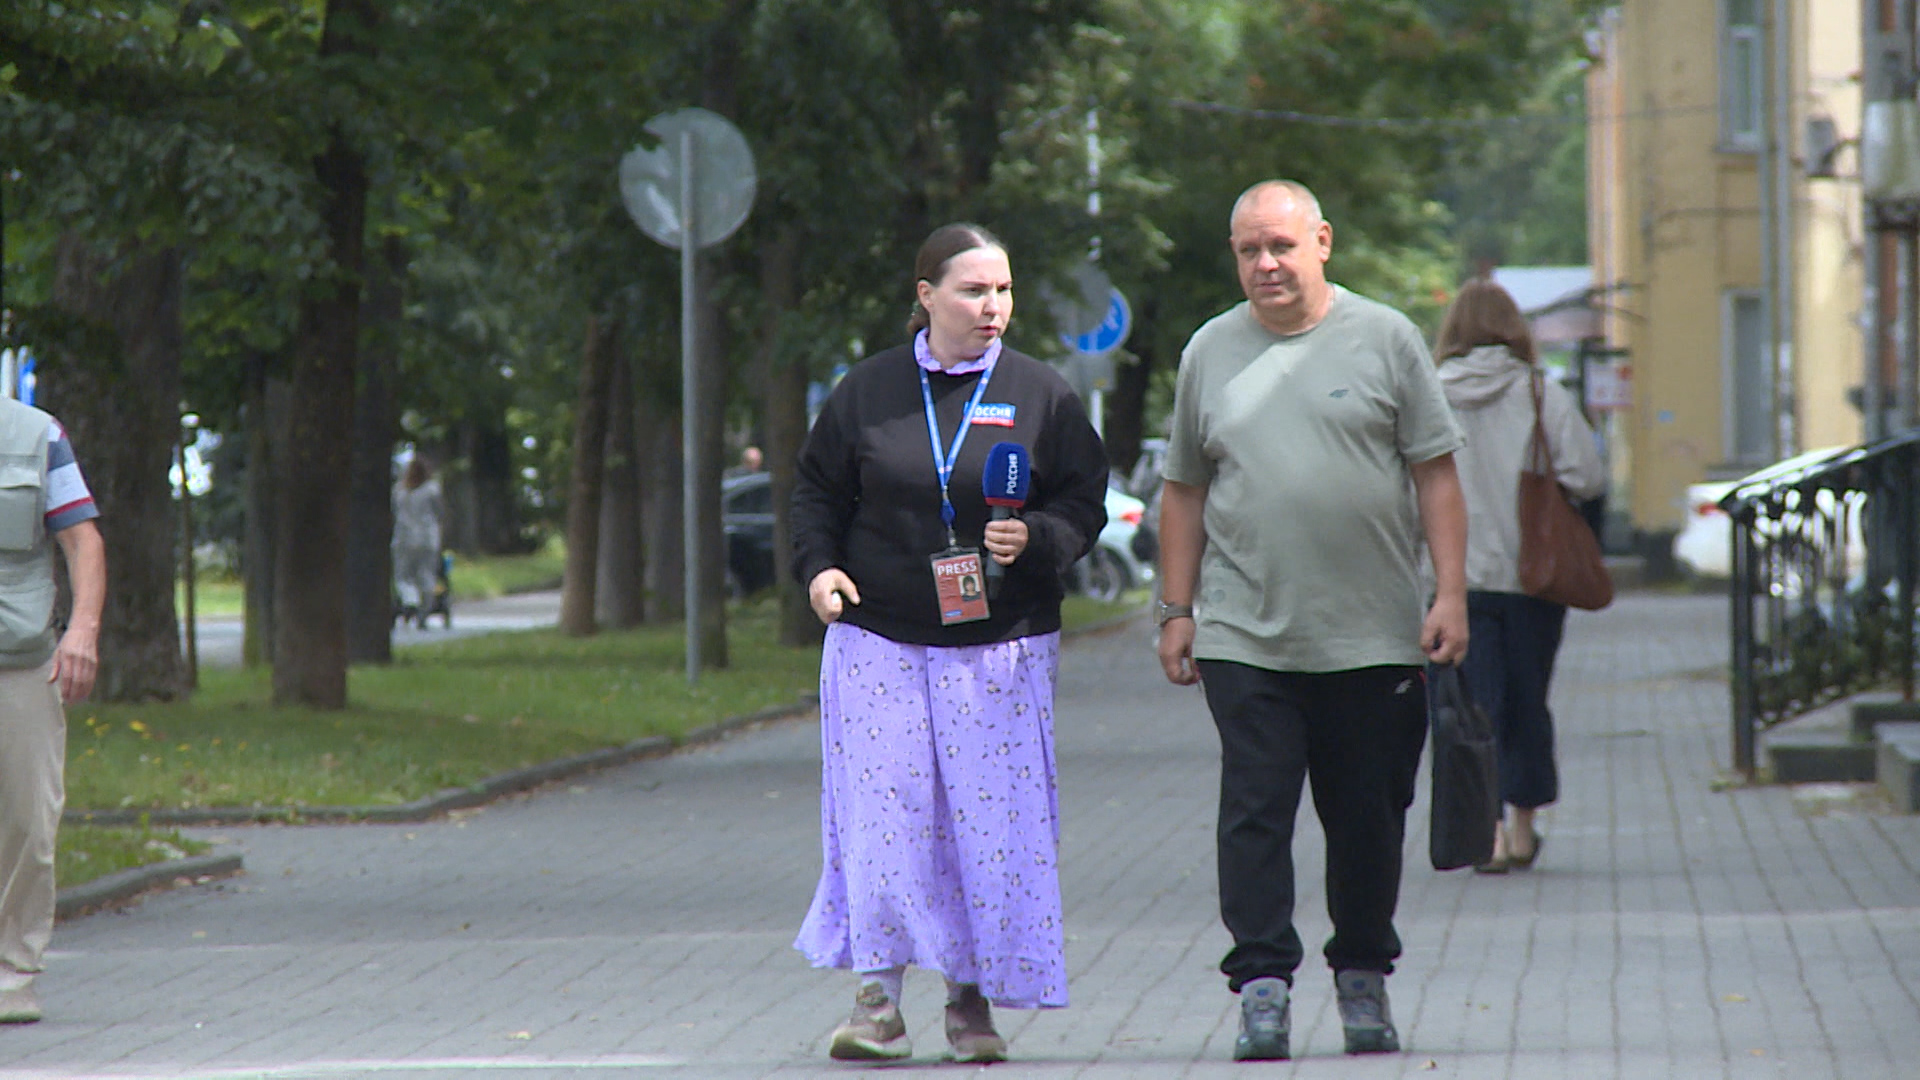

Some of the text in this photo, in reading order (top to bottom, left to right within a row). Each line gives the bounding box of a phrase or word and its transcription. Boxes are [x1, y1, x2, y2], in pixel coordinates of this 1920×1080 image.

[974, 405, 1012, 417] ОССИЯ
[1006, 453, 1018, 494] РОССИЯ
[937, 560, 977, 576] PRESS
